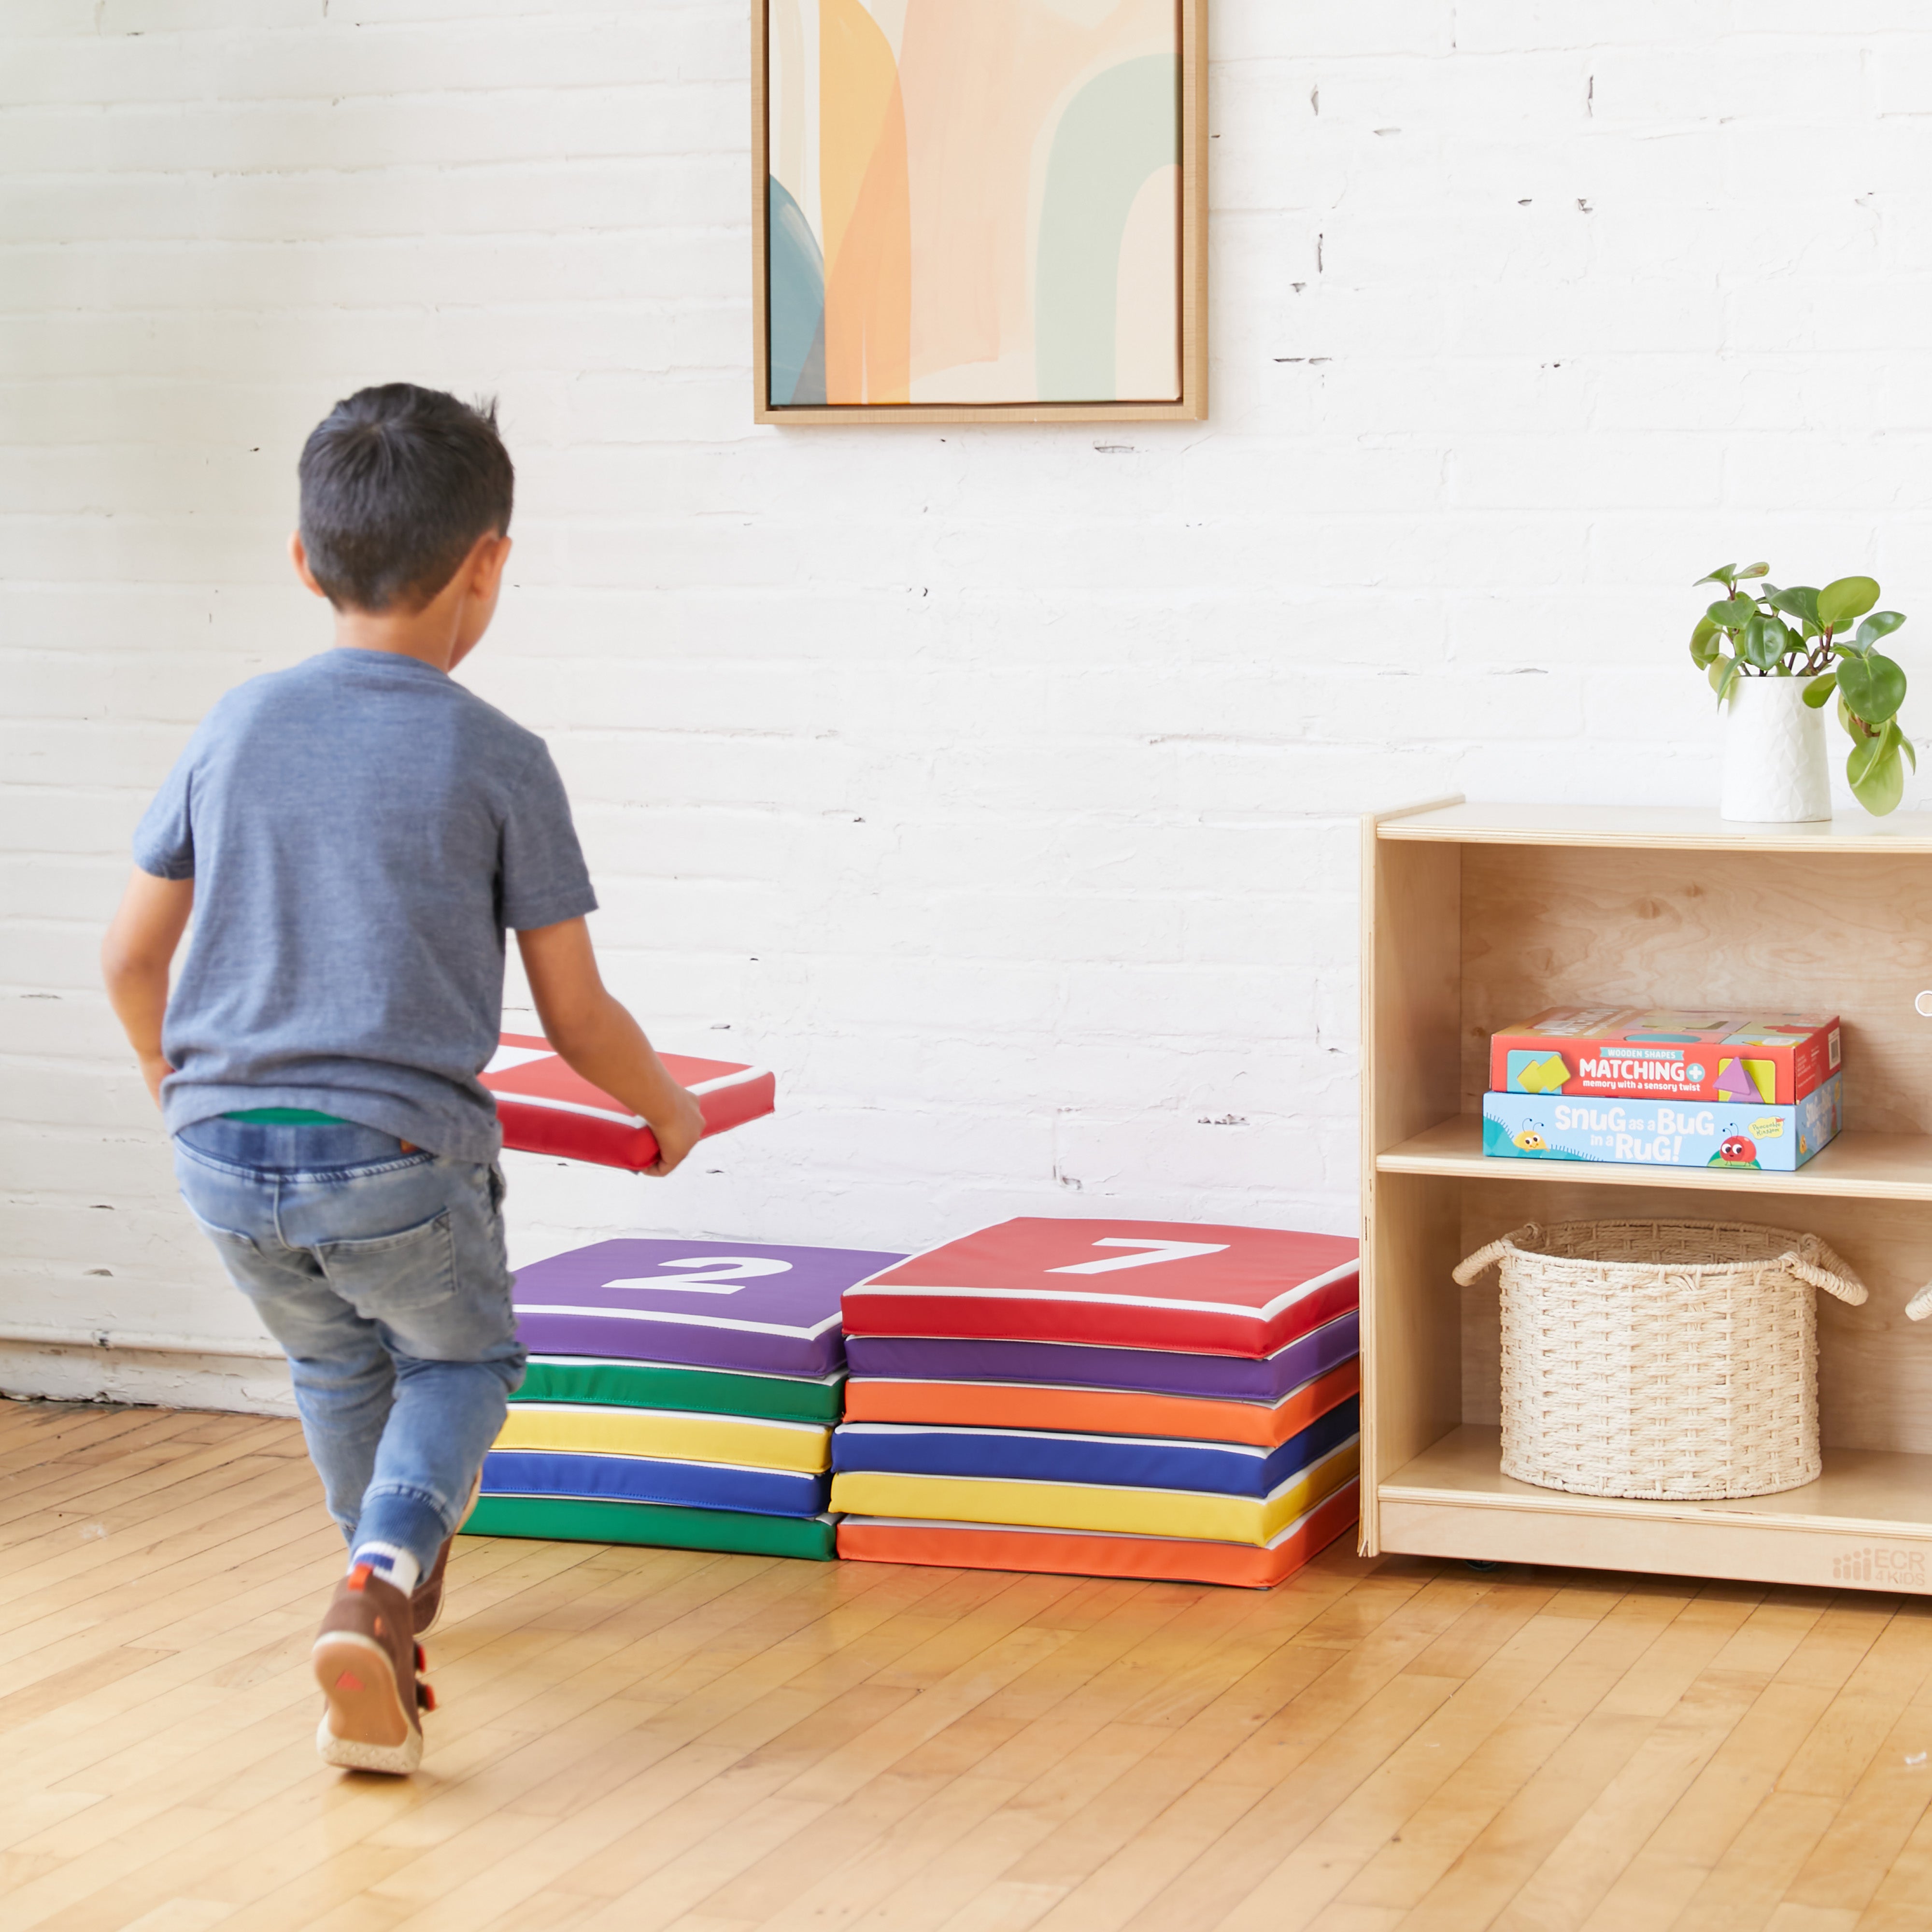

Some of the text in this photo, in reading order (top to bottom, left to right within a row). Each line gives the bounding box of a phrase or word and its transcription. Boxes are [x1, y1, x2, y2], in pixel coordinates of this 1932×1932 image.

[1607, 1049, 1676, 1059] WOODEN SHAPES
[1579, 1058, 1685, 1081] MATCHING
[1582, 1080, 1616, 1090] memory
[1618, 1080, 1636, 1089] with
[1644, 1083, 1677, 1092] sensory
[1679, 1083, 1701, 1092] twist
[1628, 1119, 1644, 1131] as
[1647, 1120, 1655, 1131] a
[1590, 1134, 1603, 1146] in
[1605, 1135, 1614, 1146] a
[1042, 1237, 1231, 1274] 7
[601, 1256, 793, 1294] 2
[1874, 1548, 1925, 1572] ECR
